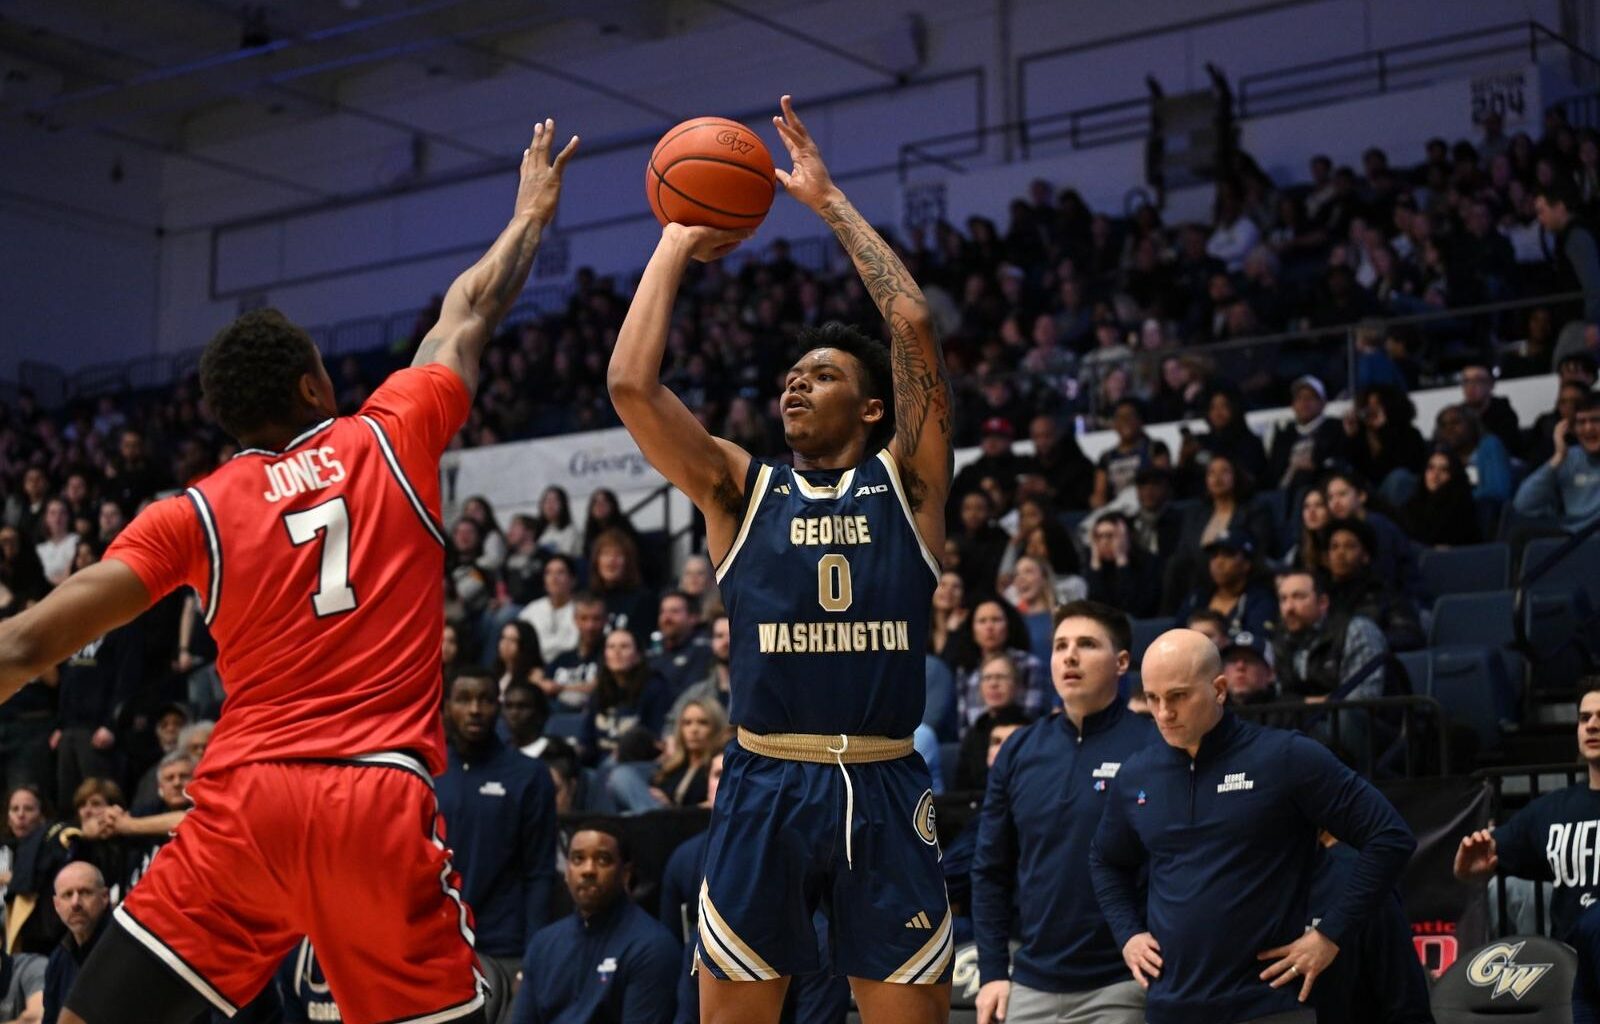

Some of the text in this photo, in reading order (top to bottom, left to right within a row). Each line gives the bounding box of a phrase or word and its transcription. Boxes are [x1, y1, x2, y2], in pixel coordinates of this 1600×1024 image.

[263, 446, 346, 503] JONES
[569, 450, 646, 478] Georg
[282, 494, 358, 619] 7
[790, 515, 871, 546] GEORGE
[817, 553, 853, 612] 0
[758, 620, 910, 653] WASHINGTON
[1466, 940, 1555, 1001] GW
